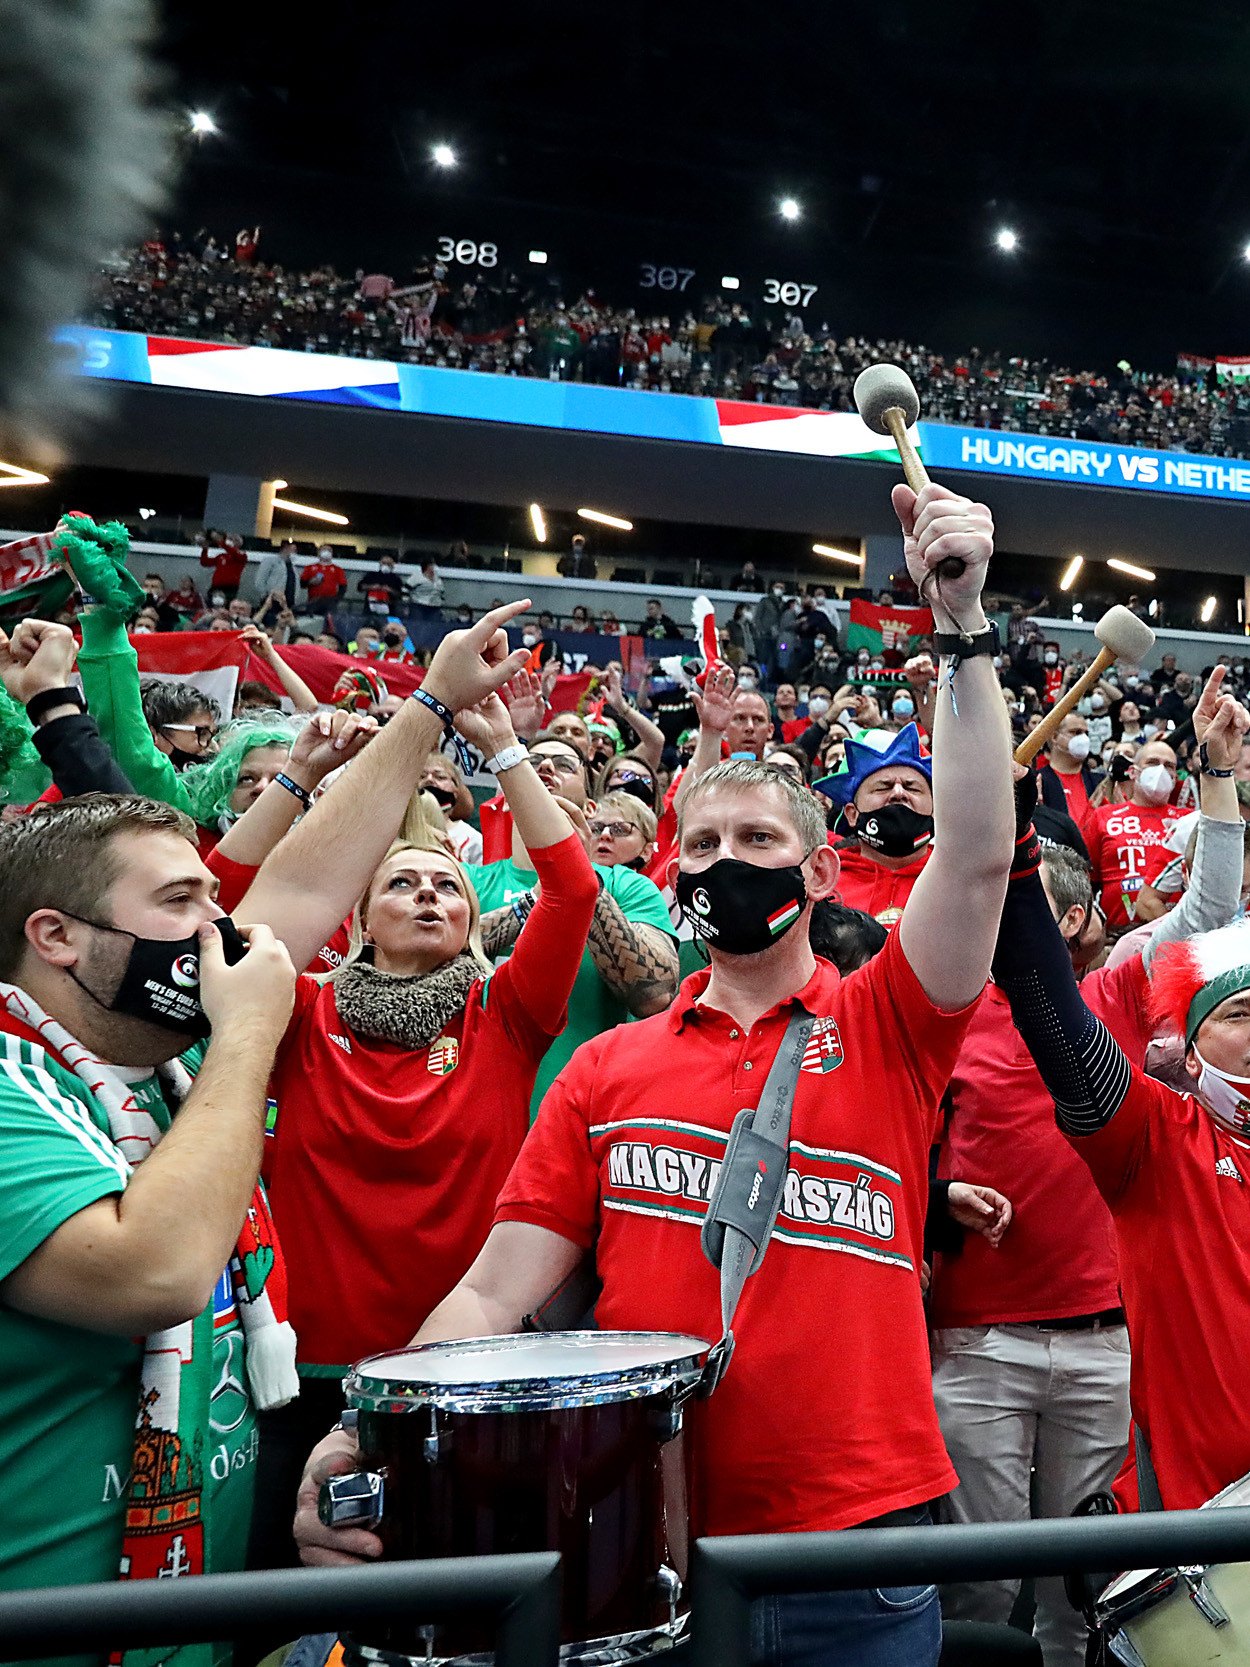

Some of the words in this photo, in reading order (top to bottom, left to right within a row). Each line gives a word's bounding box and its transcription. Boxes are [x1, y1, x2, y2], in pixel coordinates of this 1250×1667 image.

[435, 236, 498, 267] 308
[639, 263, 696, 292] 307
[763, 278, 818, 308] 307
[961, 436, 1112, 478] HUNGARY
[1117, 454, 1159, 483] VS
[1106, 816, 1141, 836] 68
[609, 1142, 895, 1240] MAGYRSZÁG
